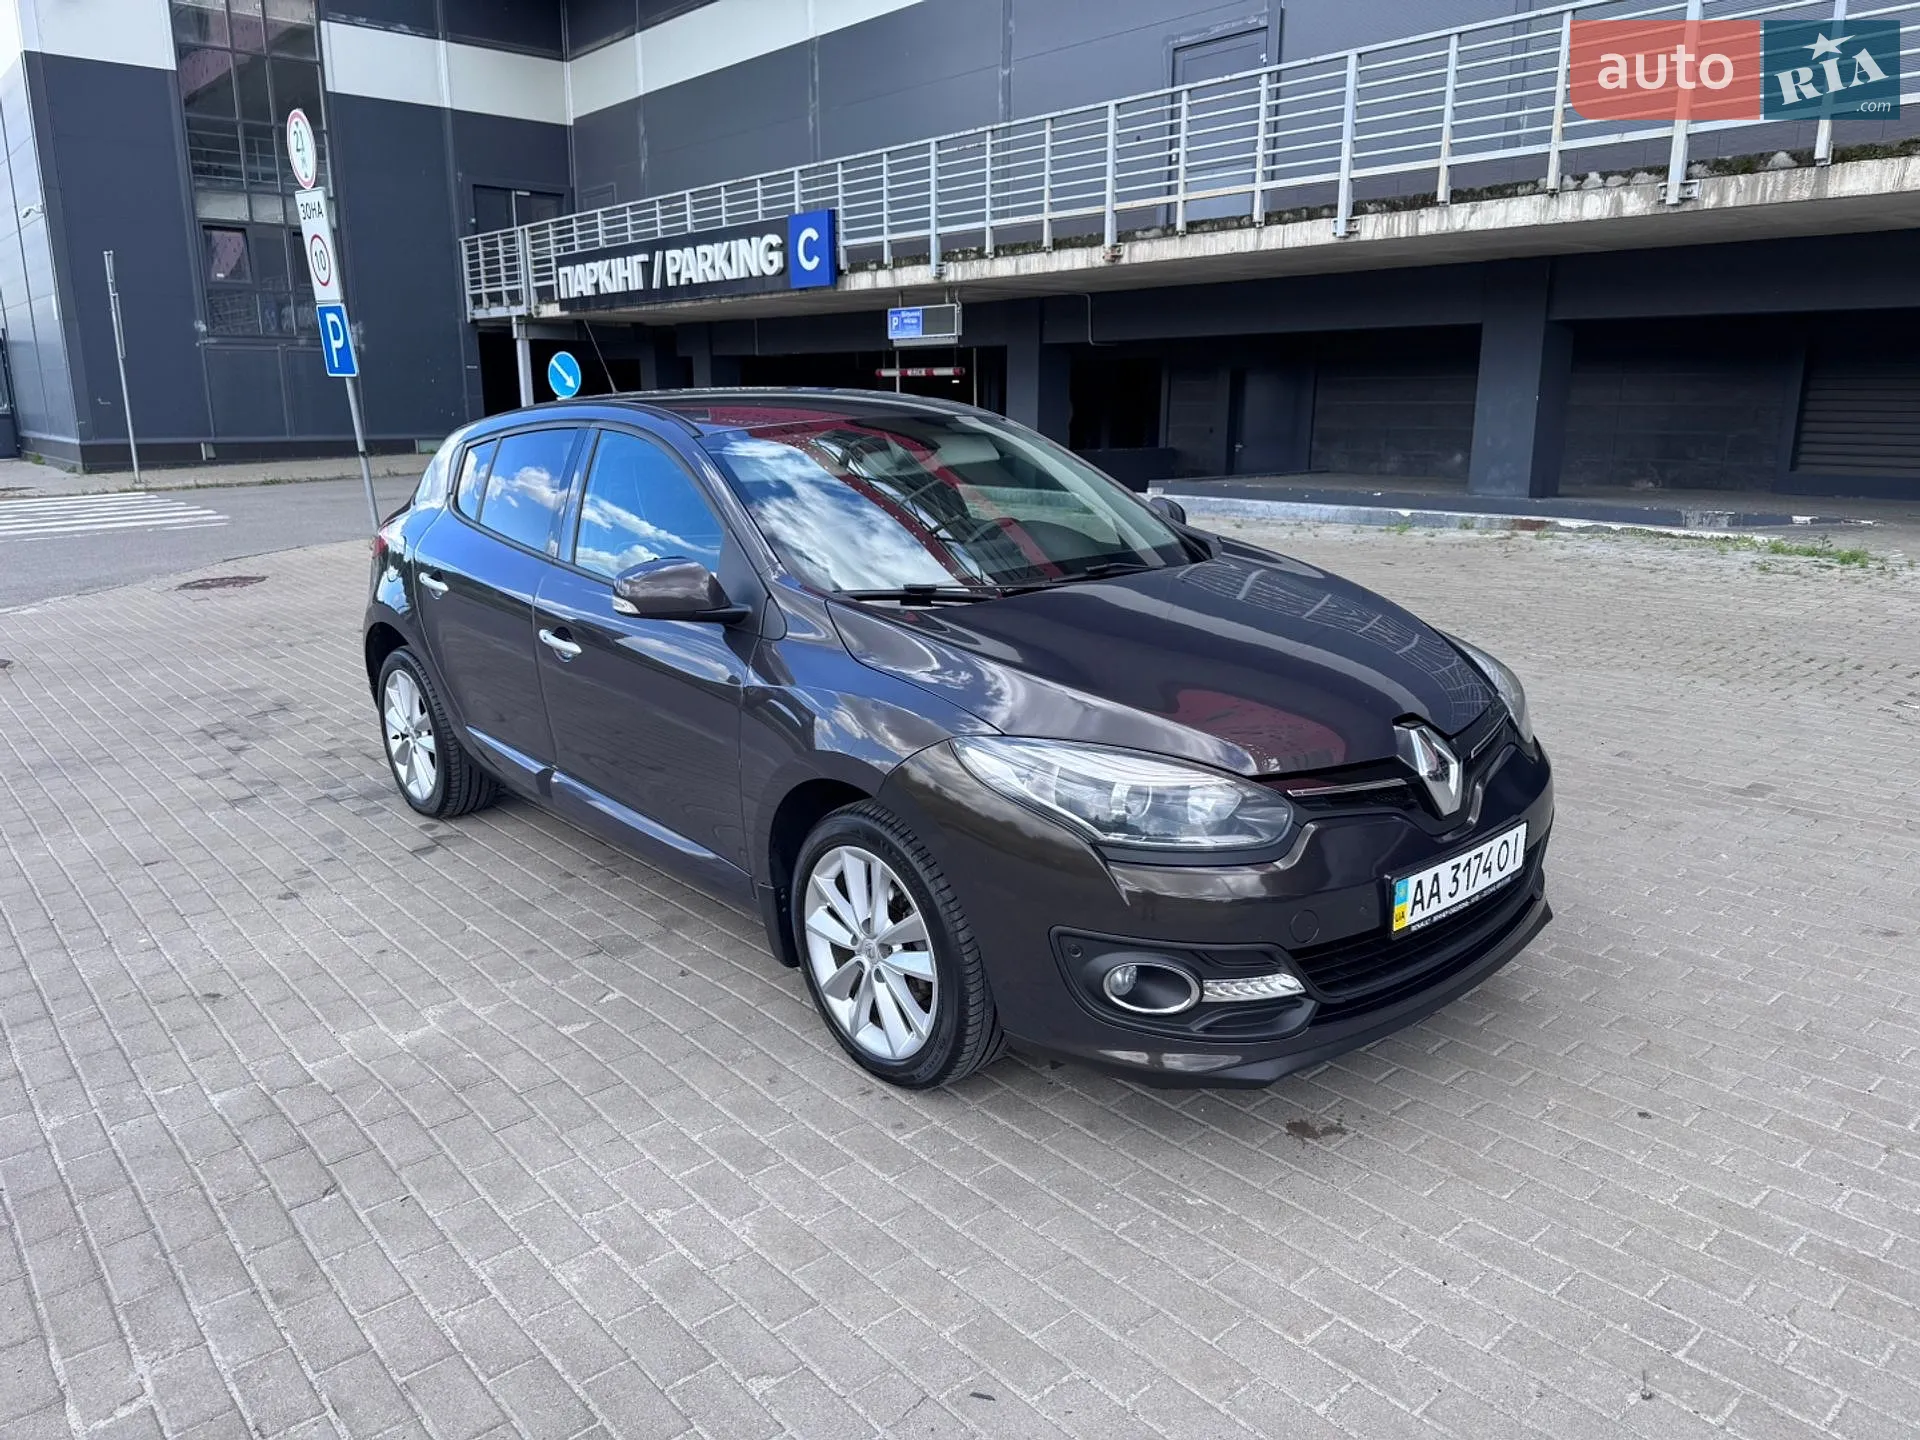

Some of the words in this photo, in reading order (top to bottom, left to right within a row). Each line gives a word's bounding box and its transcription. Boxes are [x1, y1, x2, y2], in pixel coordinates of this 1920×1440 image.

[300, 200, 324, 220] ЗОНА
[314, 250, 327, 271] 10
[558, 253, 649, 299] ПАРКІНГ
[325, 312, 344, 368] P
[1395, 911, 1405, 923] UA
